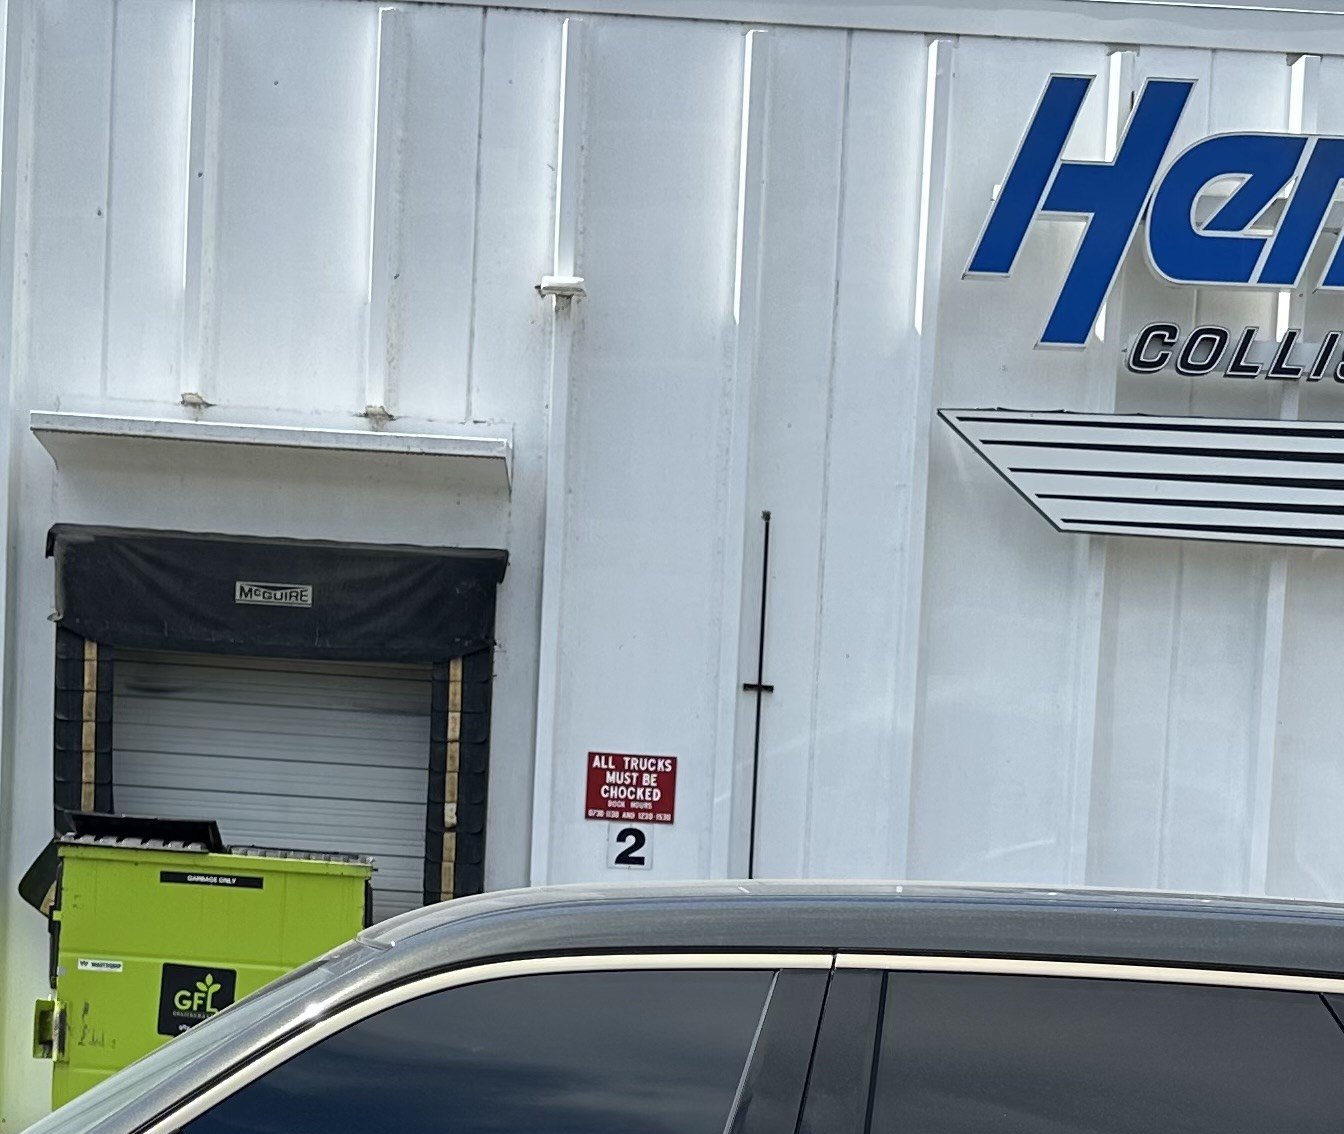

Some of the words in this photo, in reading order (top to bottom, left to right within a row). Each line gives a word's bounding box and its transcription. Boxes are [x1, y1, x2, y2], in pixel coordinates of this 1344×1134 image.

[592, 755, 616, 769] ALL
[623, 756, 672, 772] TRUCKS
[605, 770, 639, 785] MUST
[642, 773, 658, 787] BE
[600, 785, 662, 801] CHOCKED
[614, 827, 646, 866] 2
[174, 983, 219, 1013] GFL
